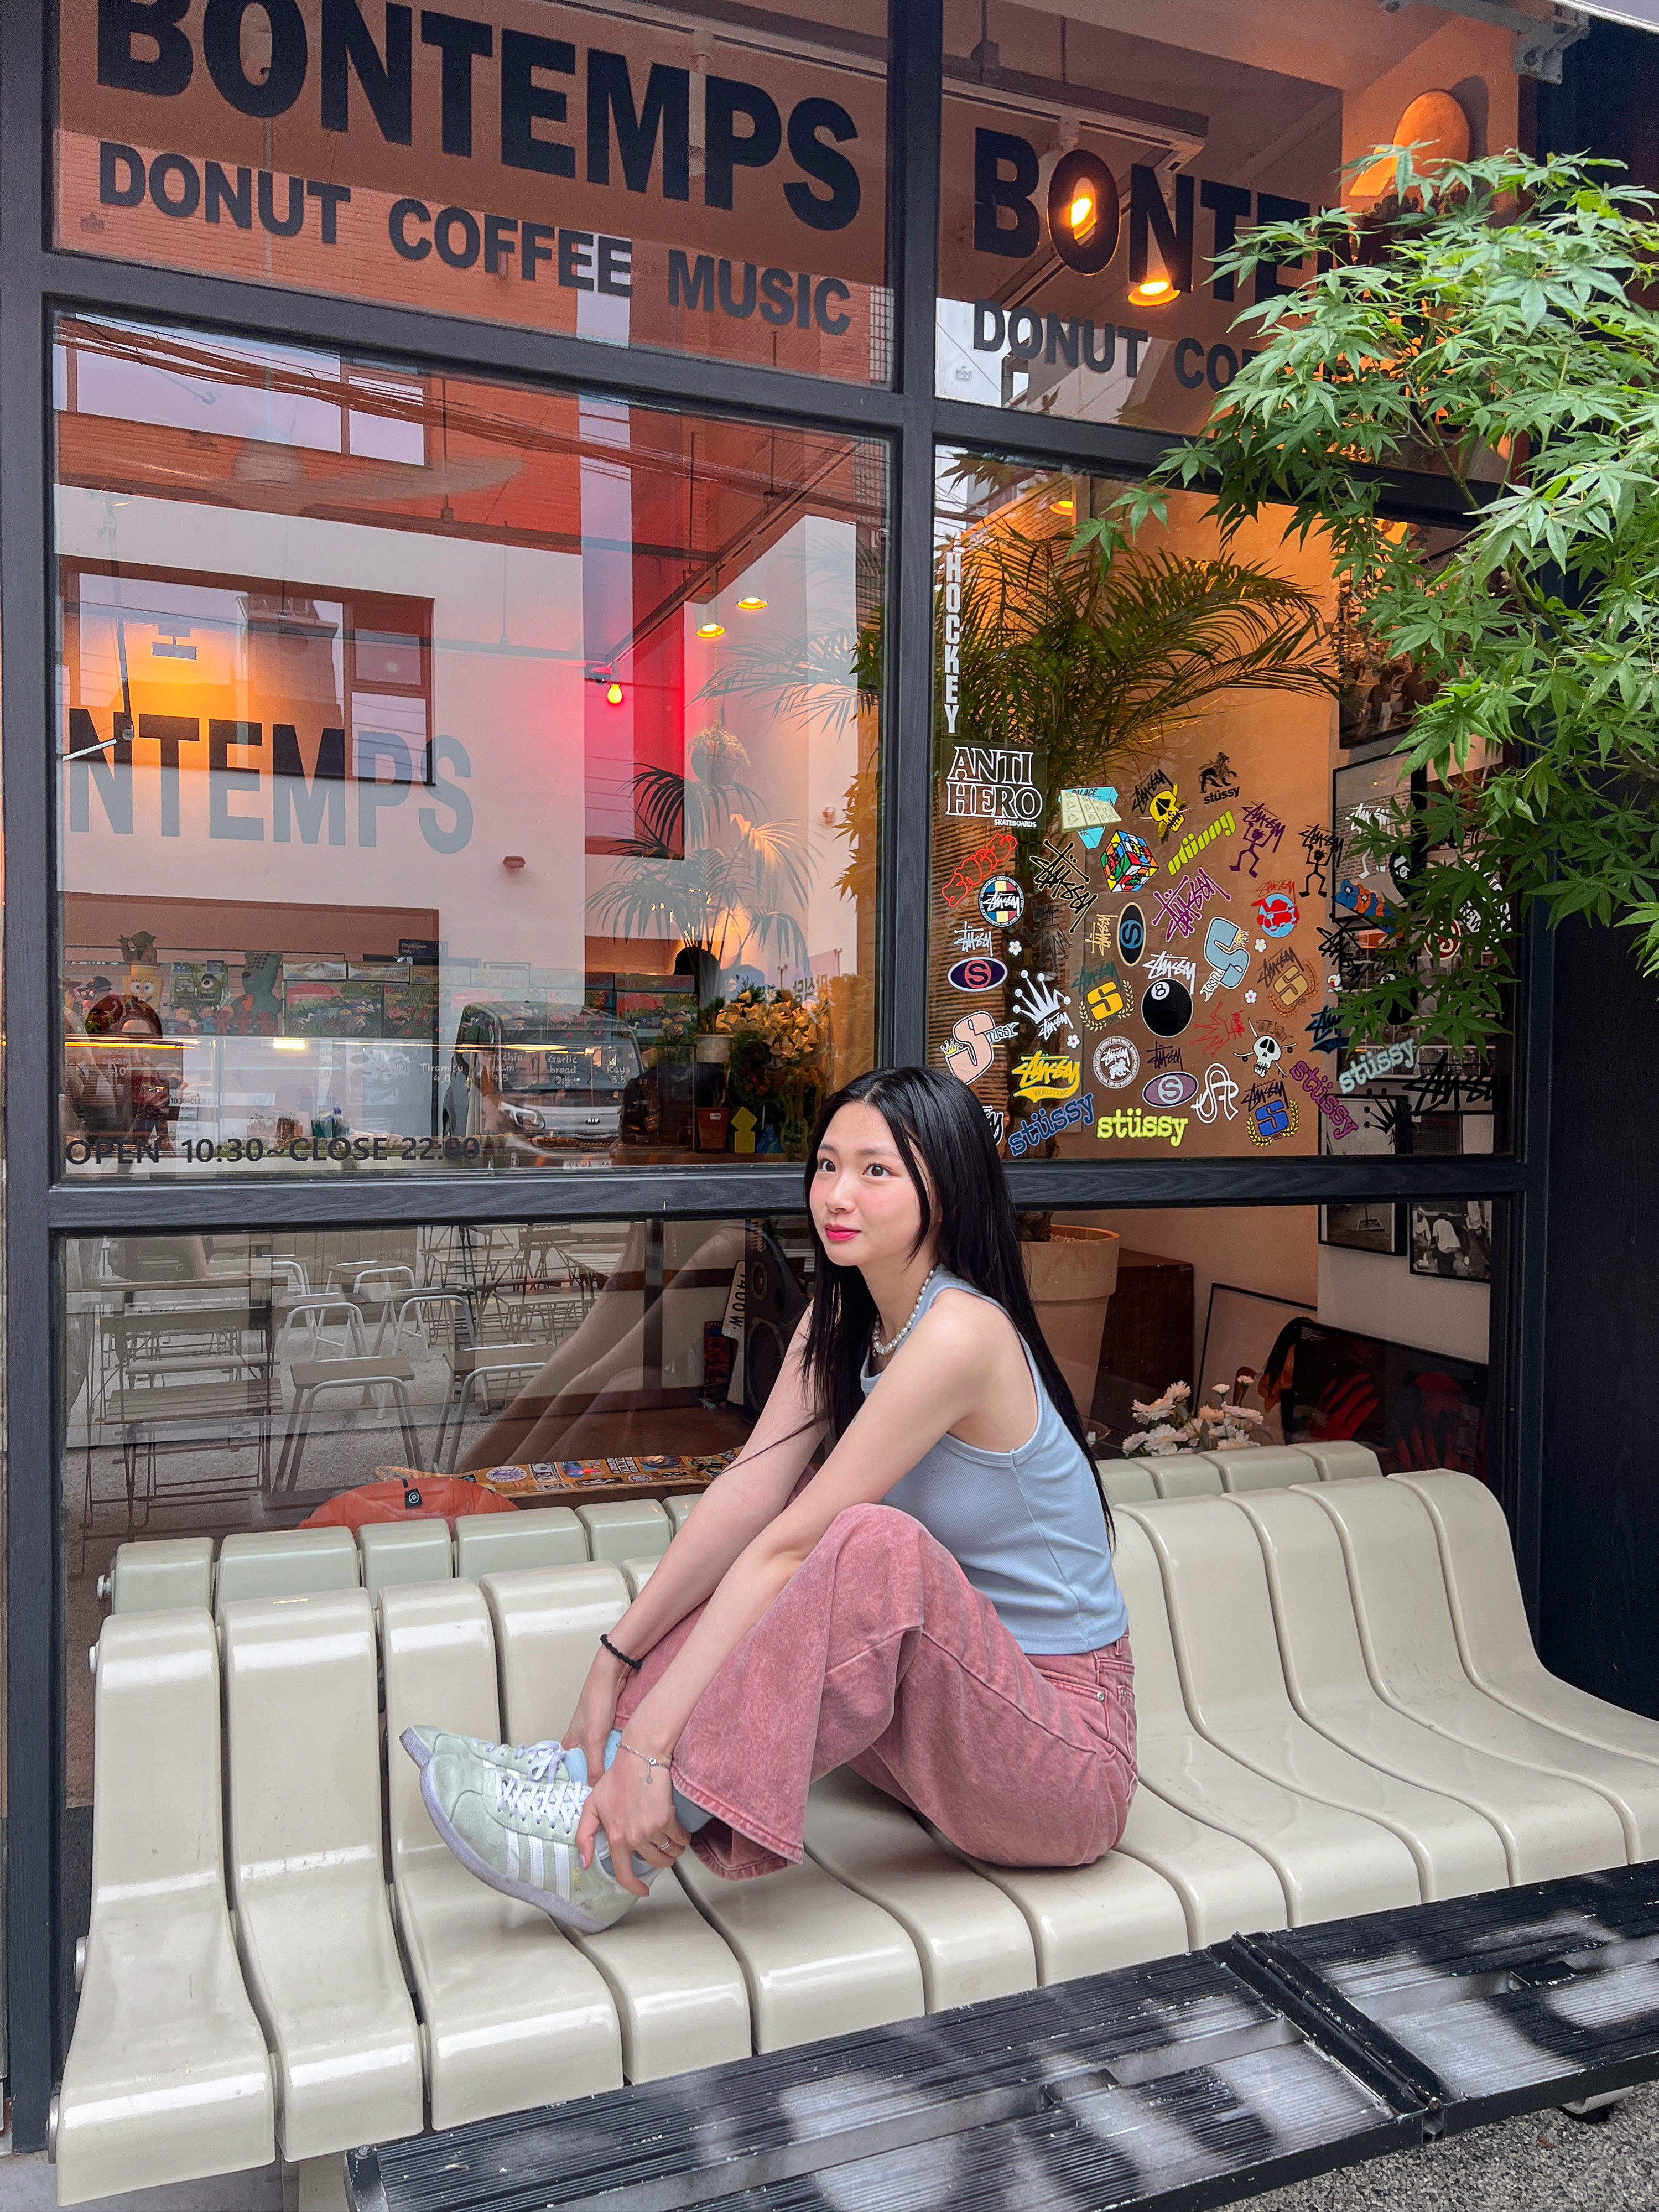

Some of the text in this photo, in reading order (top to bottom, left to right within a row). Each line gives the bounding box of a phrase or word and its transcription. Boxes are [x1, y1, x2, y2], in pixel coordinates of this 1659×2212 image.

[97, 0, 861, 231] BONTEMPS
[99, 141, 851, 335] DONUT COFFEE MUSIC
[974, 299, 1148, 378] DONUT
[944, 552, 961, 734] HOCKEY
[946, 746, 1034, 785] ANTI
[945, 781, 1043, 822] HERO
[994, 818, 1037, 828] SKATEBOARDS
[419, 1063, 464, 1072] Tiramisu
[548, 1053, 578, 1064] Garlic
[549, 1065, 576, 1074] bread
[607, 1065, 631, 1075] Kaya
[433, 1074, 451, 1083] 4.0
[611, 1076, 627, 1084] 3.5
[1008, 1093, 1095, 1157] stüssy
[1096, 1108, 1189, 1149] stüssy
[66, 1139, 159, 1164] OPEN
[401, 1136, 480, 1162] 22:00
